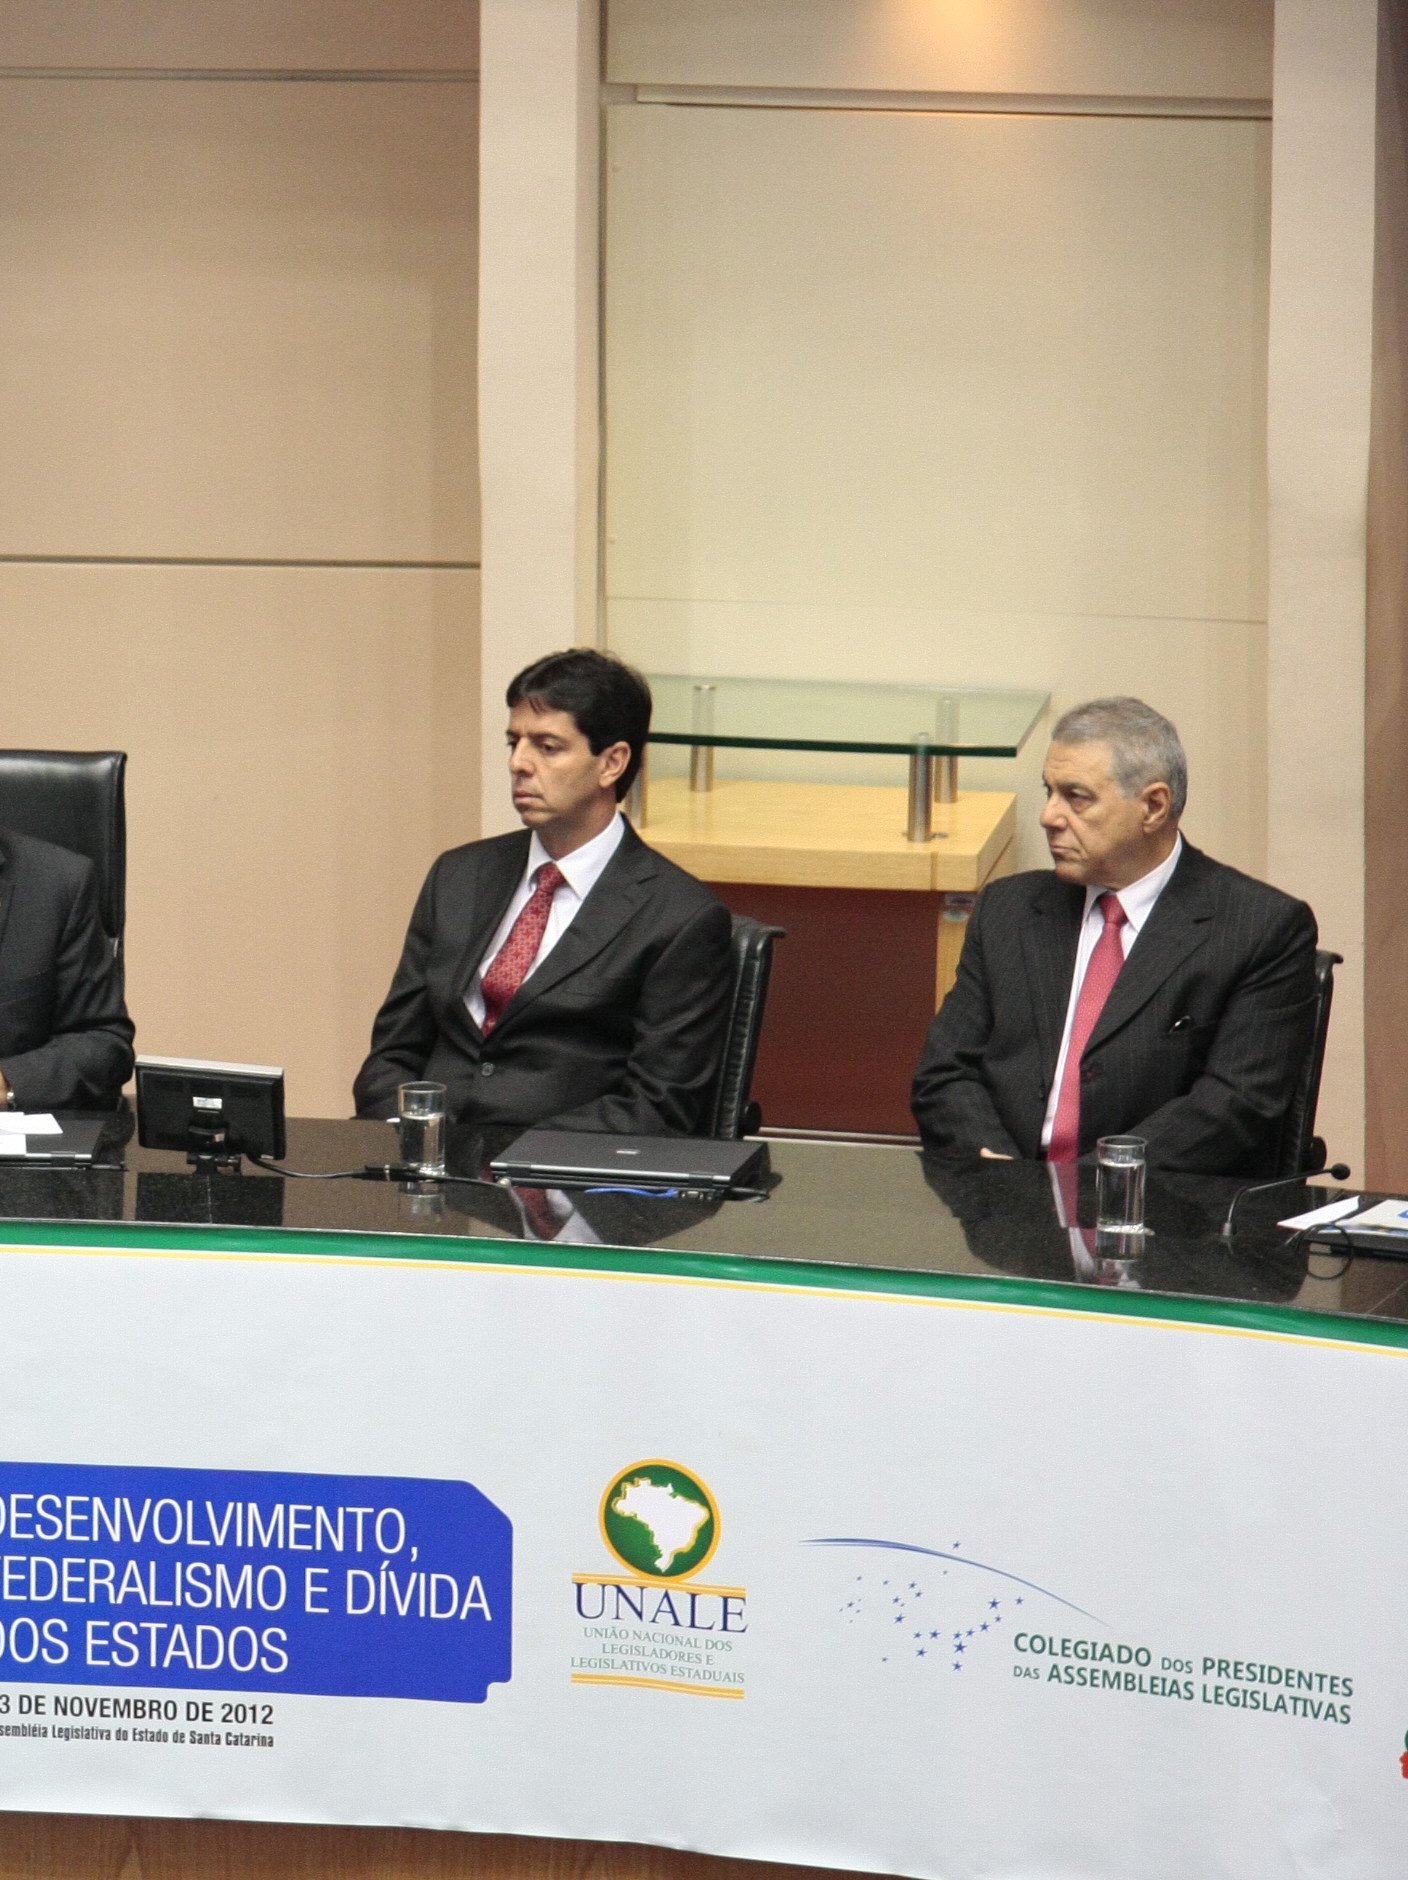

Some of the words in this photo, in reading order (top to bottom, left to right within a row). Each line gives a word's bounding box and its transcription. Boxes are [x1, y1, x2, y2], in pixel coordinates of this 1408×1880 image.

[304, 1567, 330, 1613] E
[346, 1560, 493, 1621] DÍVIDA
[573, 1582, 749, 1634] UNALE
[85, 1619, 289, 1674] ESTADOS
[583, 1626, 629, 1640] UNIÃO
[632, 1630, 702, 1649] NACIONAL
[705, 1638, 733, 1652] DOS
[602, 1642, 702, 1664] LEGISLADORES
[705, 1654, 714, 1665] E
[570, 1656, 668, 1675] LEGISLATIVOS
[670, 1664, 745, 1683] ESTADUAIS
[1013, 1632, 1152, 1667] COLEGIADO
[1161, 1656, 1193, 1674] DOS
[1202, 1656, 1354, 1698] PRESIDENTES
[18, 1694, 47, 1715] DE
[54, 1696, 178, 1721] NOVEMBRO
[186, 1701, 214, 1722] DE
[220, 1703, 274, 1725] 2012
[1013, 1665, 1041, 1680] DAS
[1047, 1663, 1194, 1701] ASSEMBLEIAS
[1202, 1684, 1351, 1725] LEGISLATIVAS
[52, 1725, 111, 1742] Legislativa
[115, 1727, 129, 1741] do
[132, 1727, 168, 1743] Estado
[172, 1729, 185, 1744] de
[189, 1730, 221, 1746] Santa
[225, 1732, 274, 1747] Catarina
